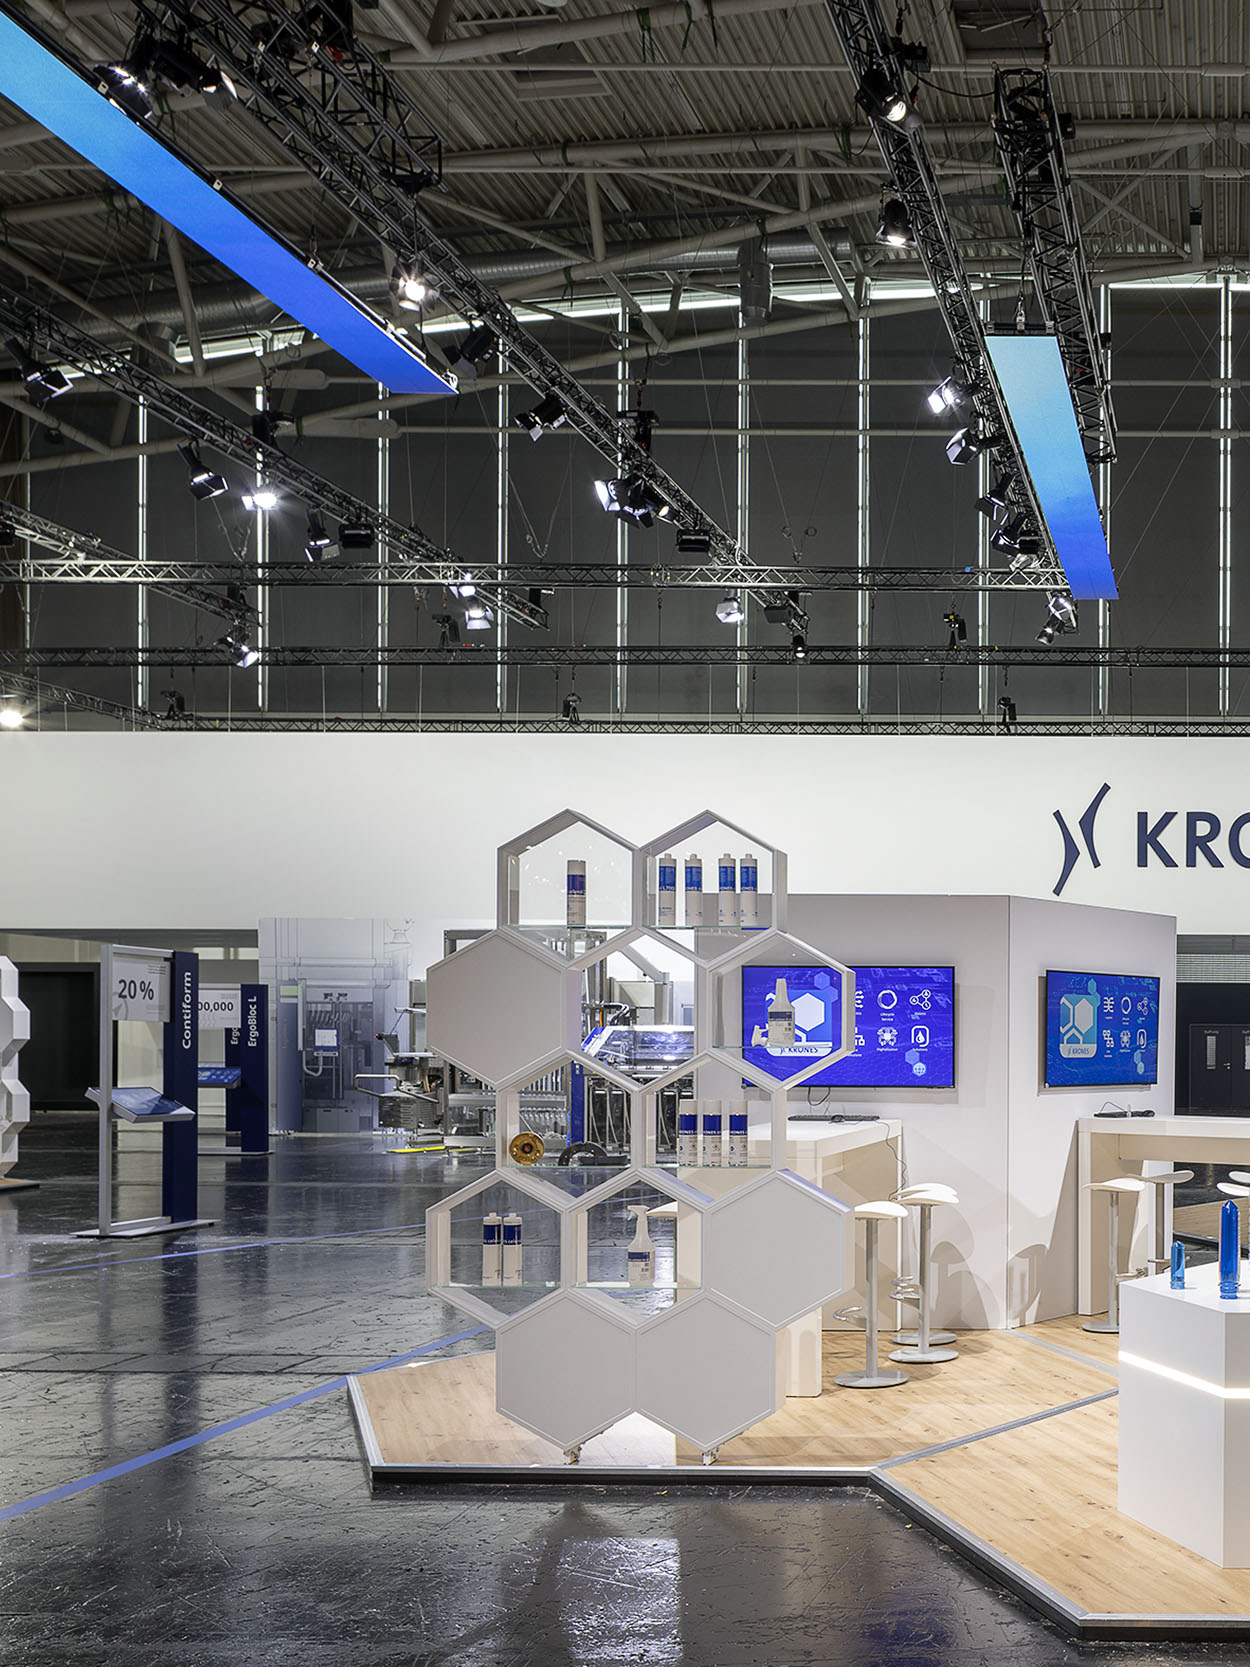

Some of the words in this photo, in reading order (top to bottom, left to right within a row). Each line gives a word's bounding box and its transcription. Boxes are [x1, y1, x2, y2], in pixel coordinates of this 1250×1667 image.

[118, 979, 137, 1000] 20
[182, 972, 192, 1050] Contiform
[247, 1005, 259, 1047] ErgoBloc
